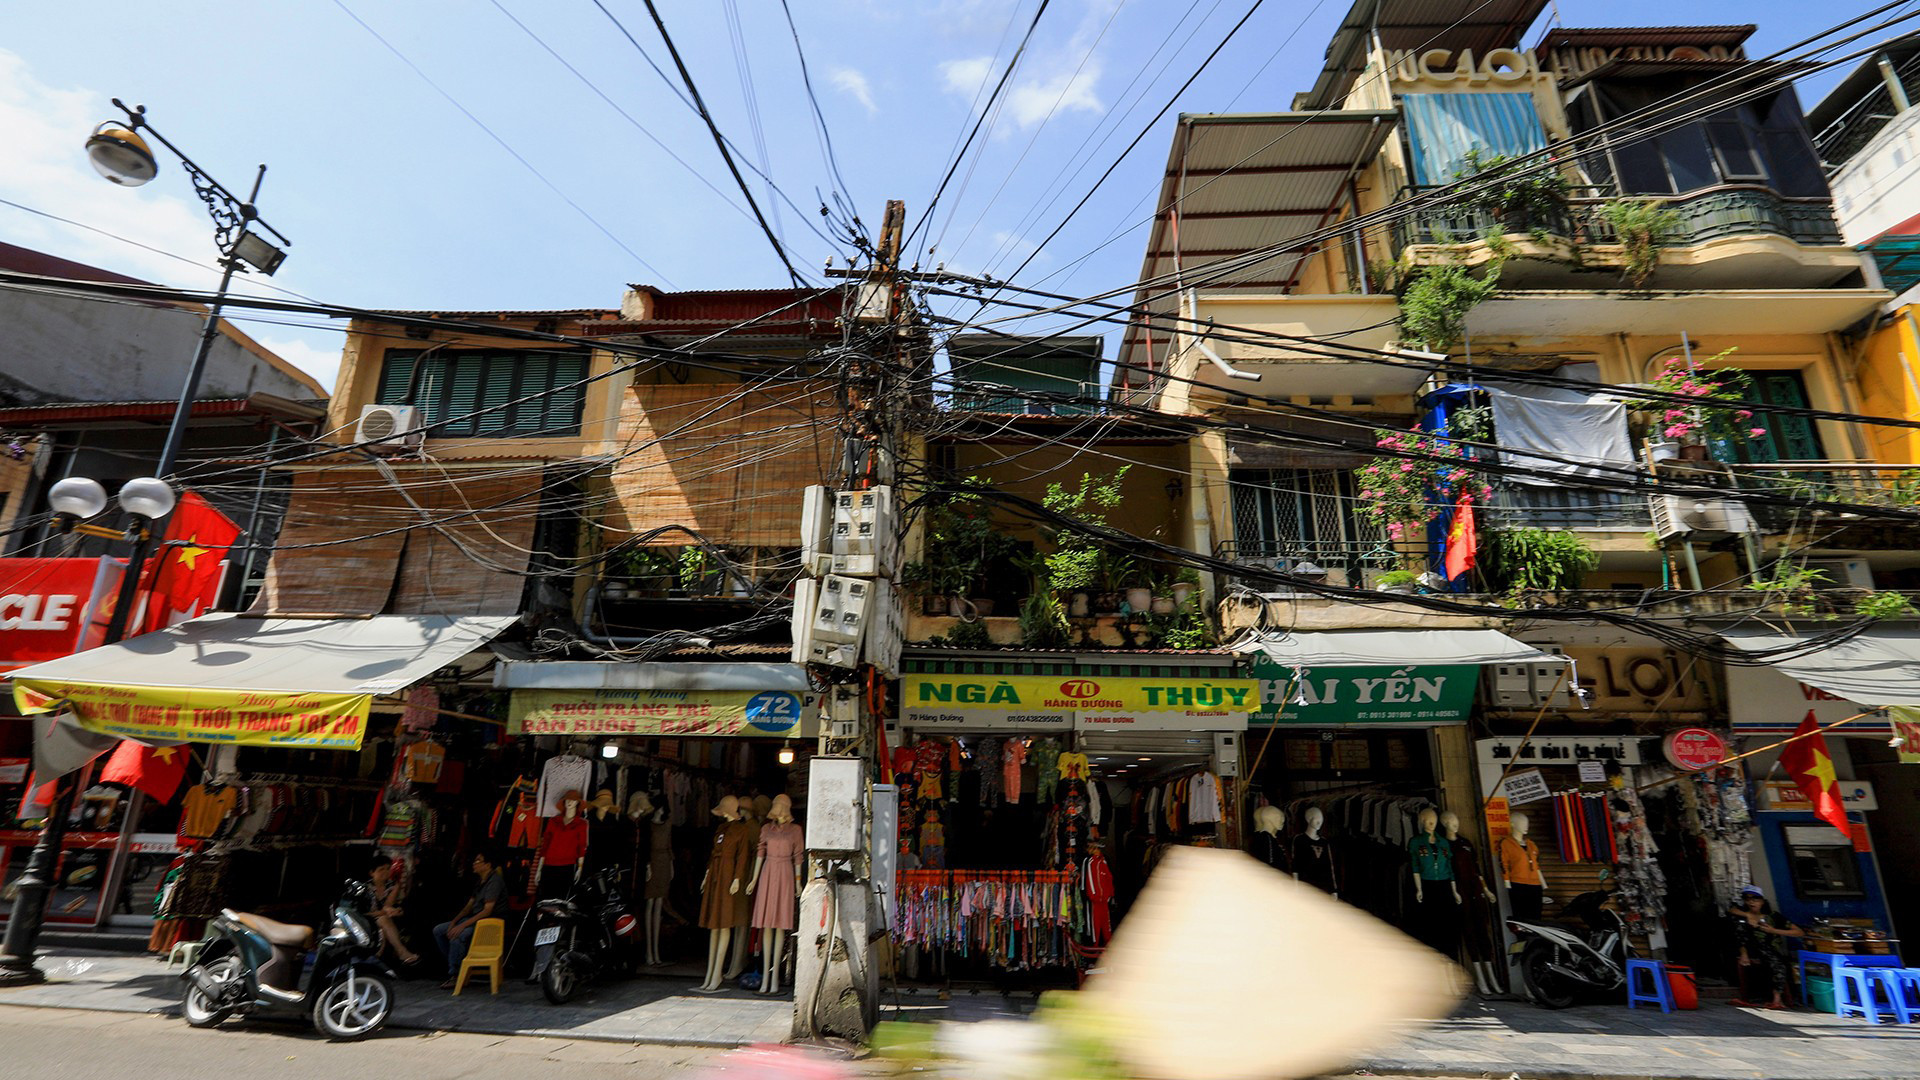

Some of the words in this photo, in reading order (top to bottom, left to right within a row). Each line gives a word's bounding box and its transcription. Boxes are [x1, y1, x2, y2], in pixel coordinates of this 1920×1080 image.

[919, 681, 1022, 705] NGÀ
[1069, 681, 1096, 697] 70
[1351, 665, 1447, 704] YẾN
[1044, 698, 1078, 708] HÀNG
[1081, 699, 1123, 708] ĐƯỜNG
[1141, 683, 1249, 706] THÙY
[602, 703, 668, 716] TRANG
[674, 699, 712, 716] TRẺ
[757, 696, 791, 714] 72
[237, 710, 294, 733] TRANG
[332, 715, 360, 735] EM
[574, 717, 636, 732] BUÔN
